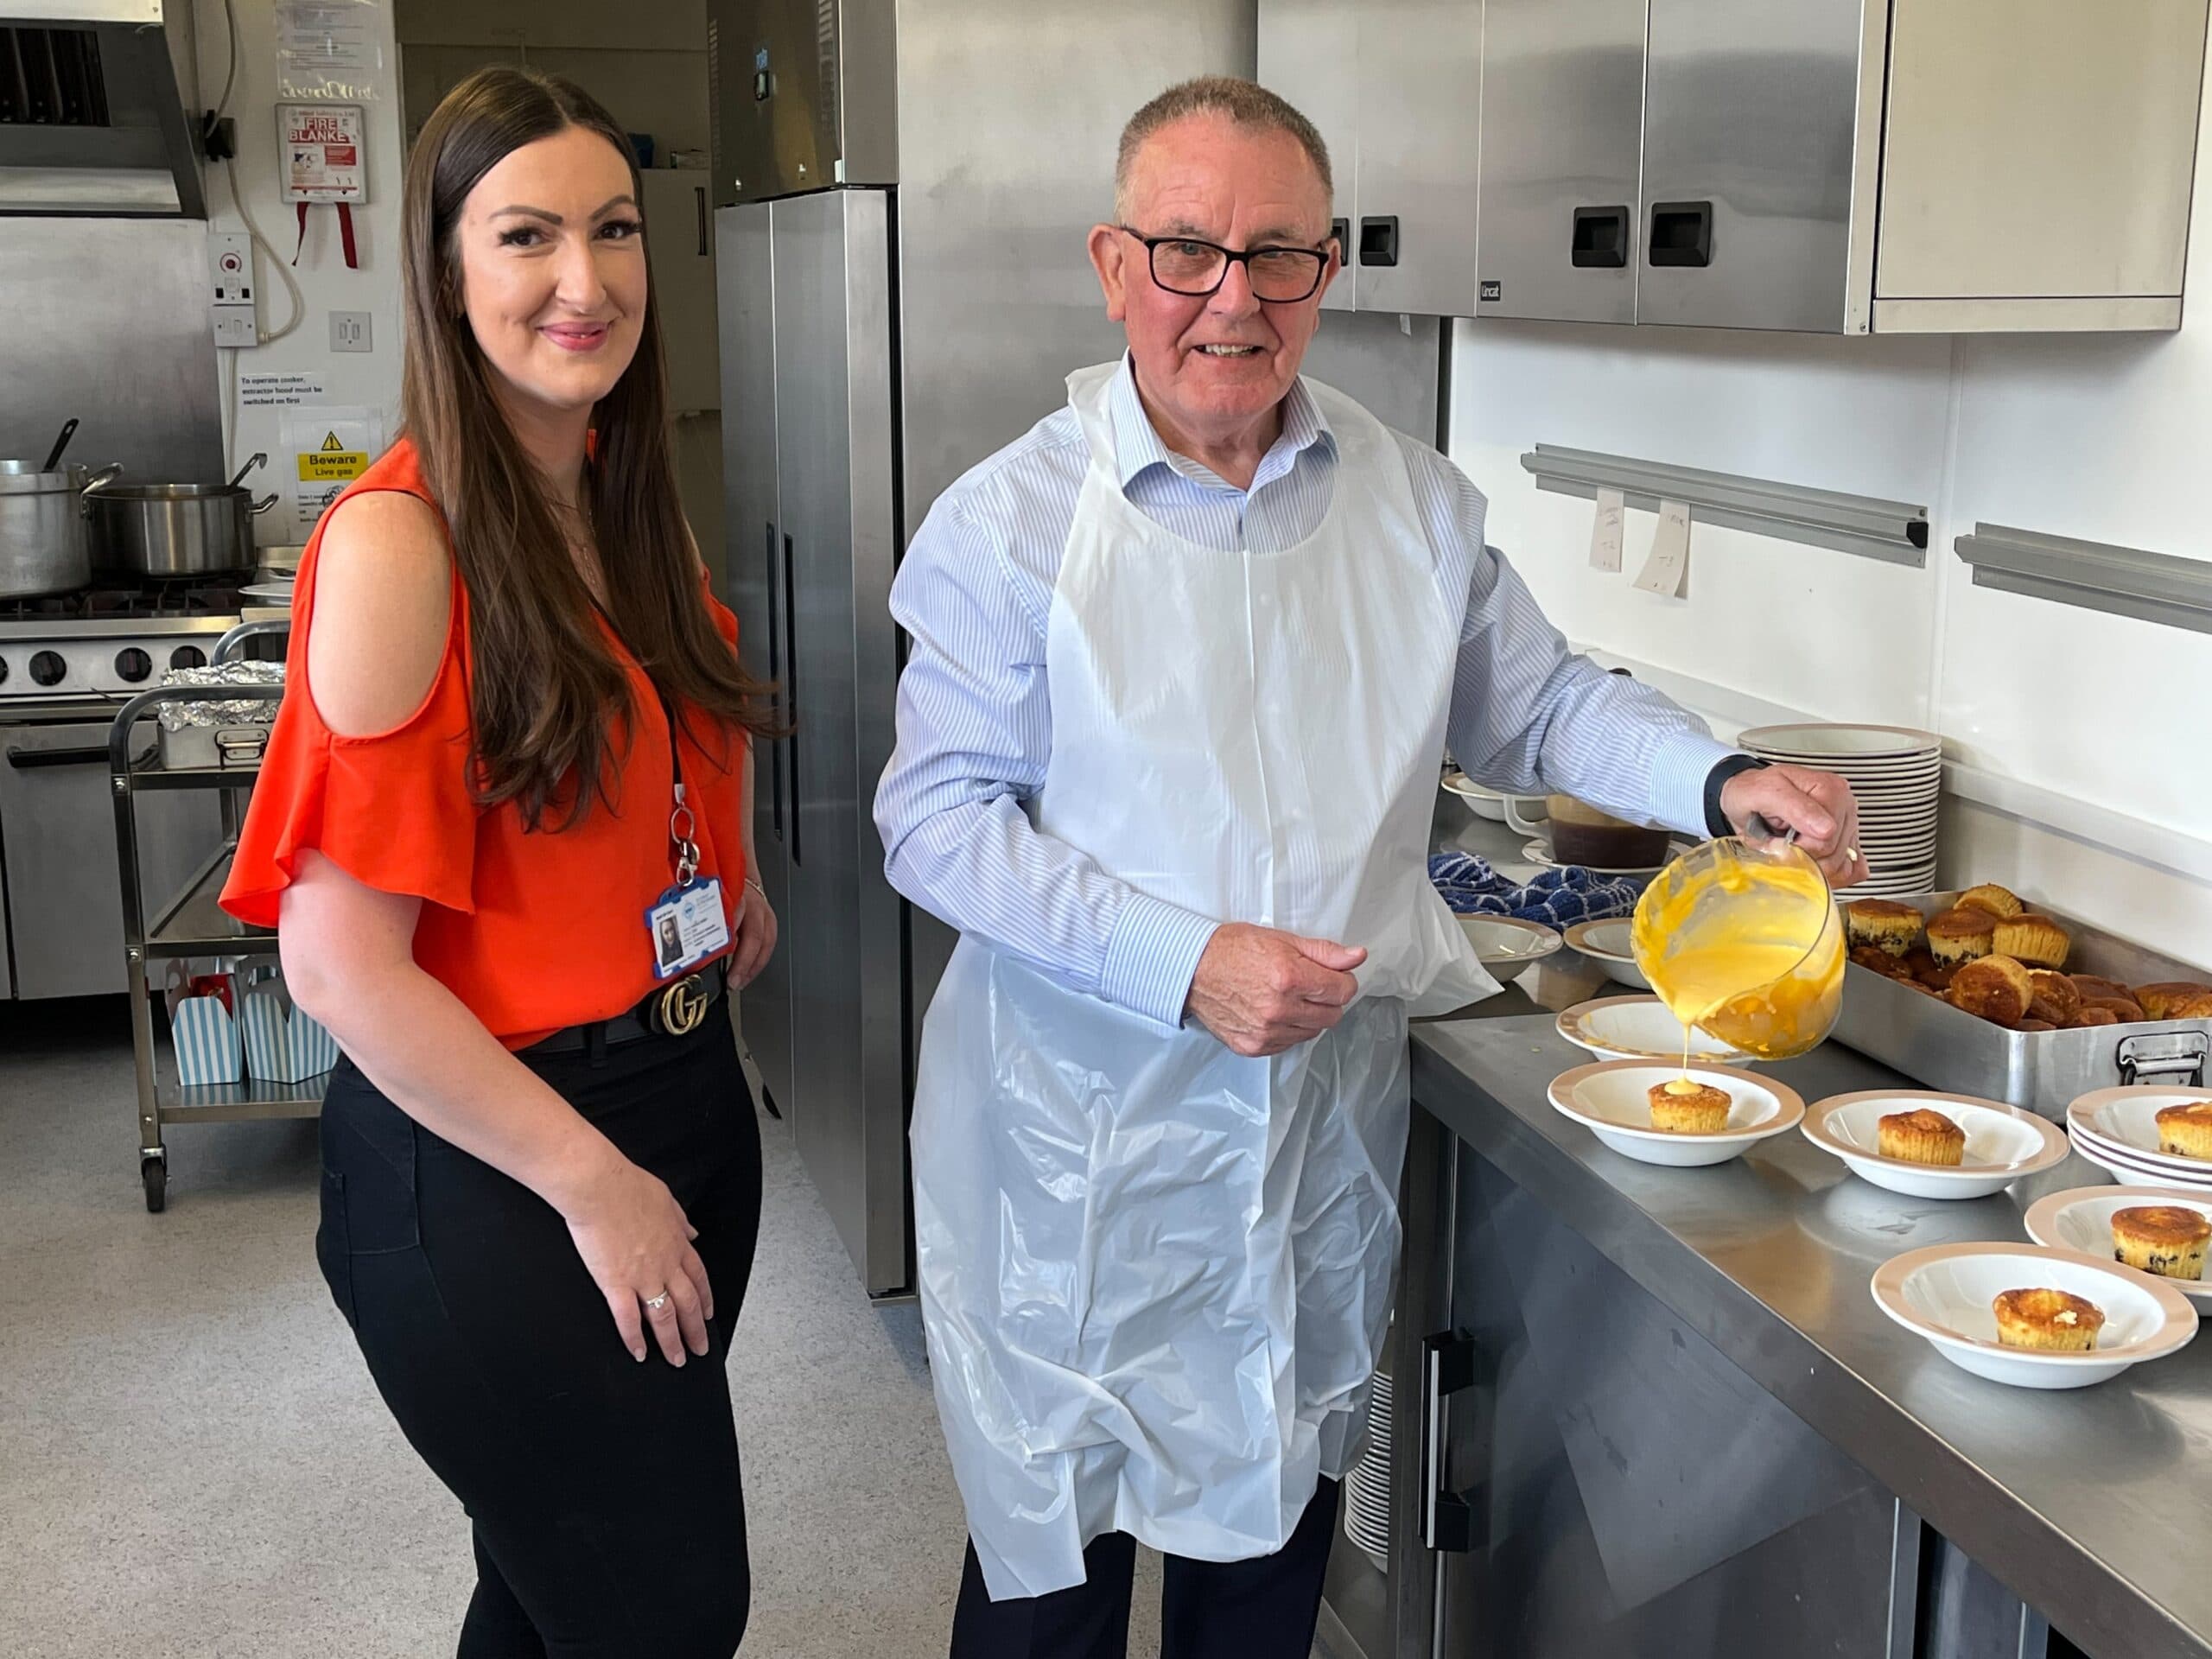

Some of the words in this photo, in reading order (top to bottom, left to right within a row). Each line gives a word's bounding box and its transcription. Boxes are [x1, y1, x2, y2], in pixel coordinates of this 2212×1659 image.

[306, 118, 338, 130] FIRE
[289, 130, 353, 143] BLANKE
[309, 454, 357, 465] Beware
[337, 468, 353, 478] gas
